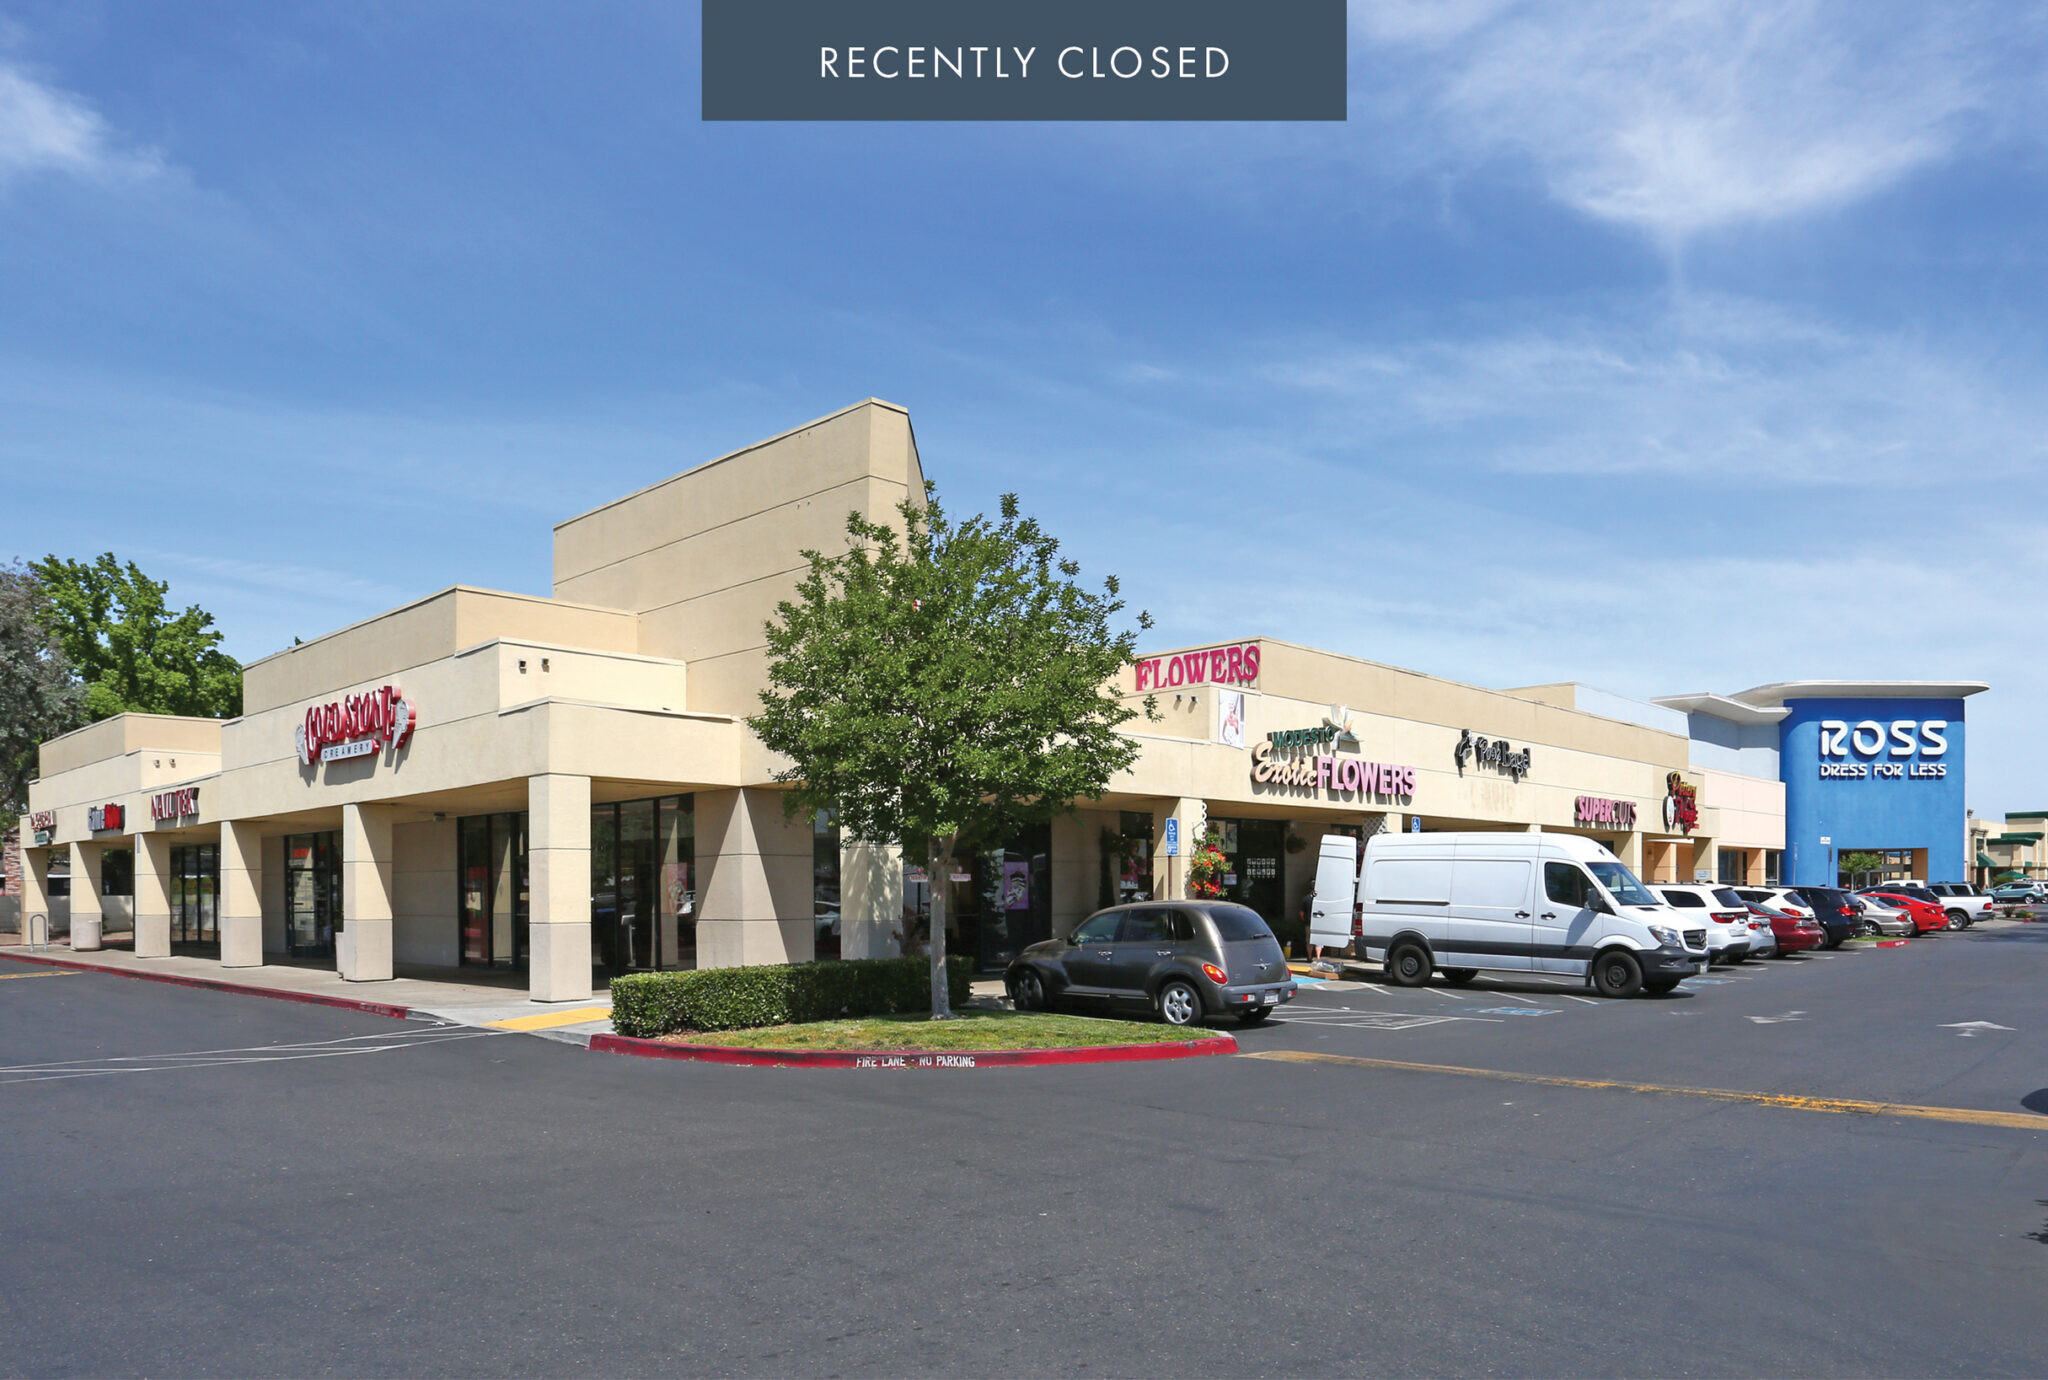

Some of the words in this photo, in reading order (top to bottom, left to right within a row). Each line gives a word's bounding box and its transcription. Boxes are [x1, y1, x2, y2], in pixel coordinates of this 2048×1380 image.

[1135, 645, 1260, 691] FLOWERS
[323, 742, 373, 759] CREAMERY
[1273, 726, 1335, 748] MODESTO
[1821, 720, 1948, 755] ROSS
[1253, 741, 1318, 788] Exotic
[1317, 756, 1417, 796] FLOWERS
[1820, 763, 1868, 777] DRESS
[1874, 763, 1904, 777] FOR
[1910, 763, 1947, 777] LESS
[151, 792, 174, 821] NAIL
[176, 787, 197, 817] TEK
[1577, 795, 1637, 825] SUPERCUTS
[856, 1056, 878, 1068] FIRE
[881, 1056, 907, 1067] LANE
[936, 1055, 976, 1068] PARKING
